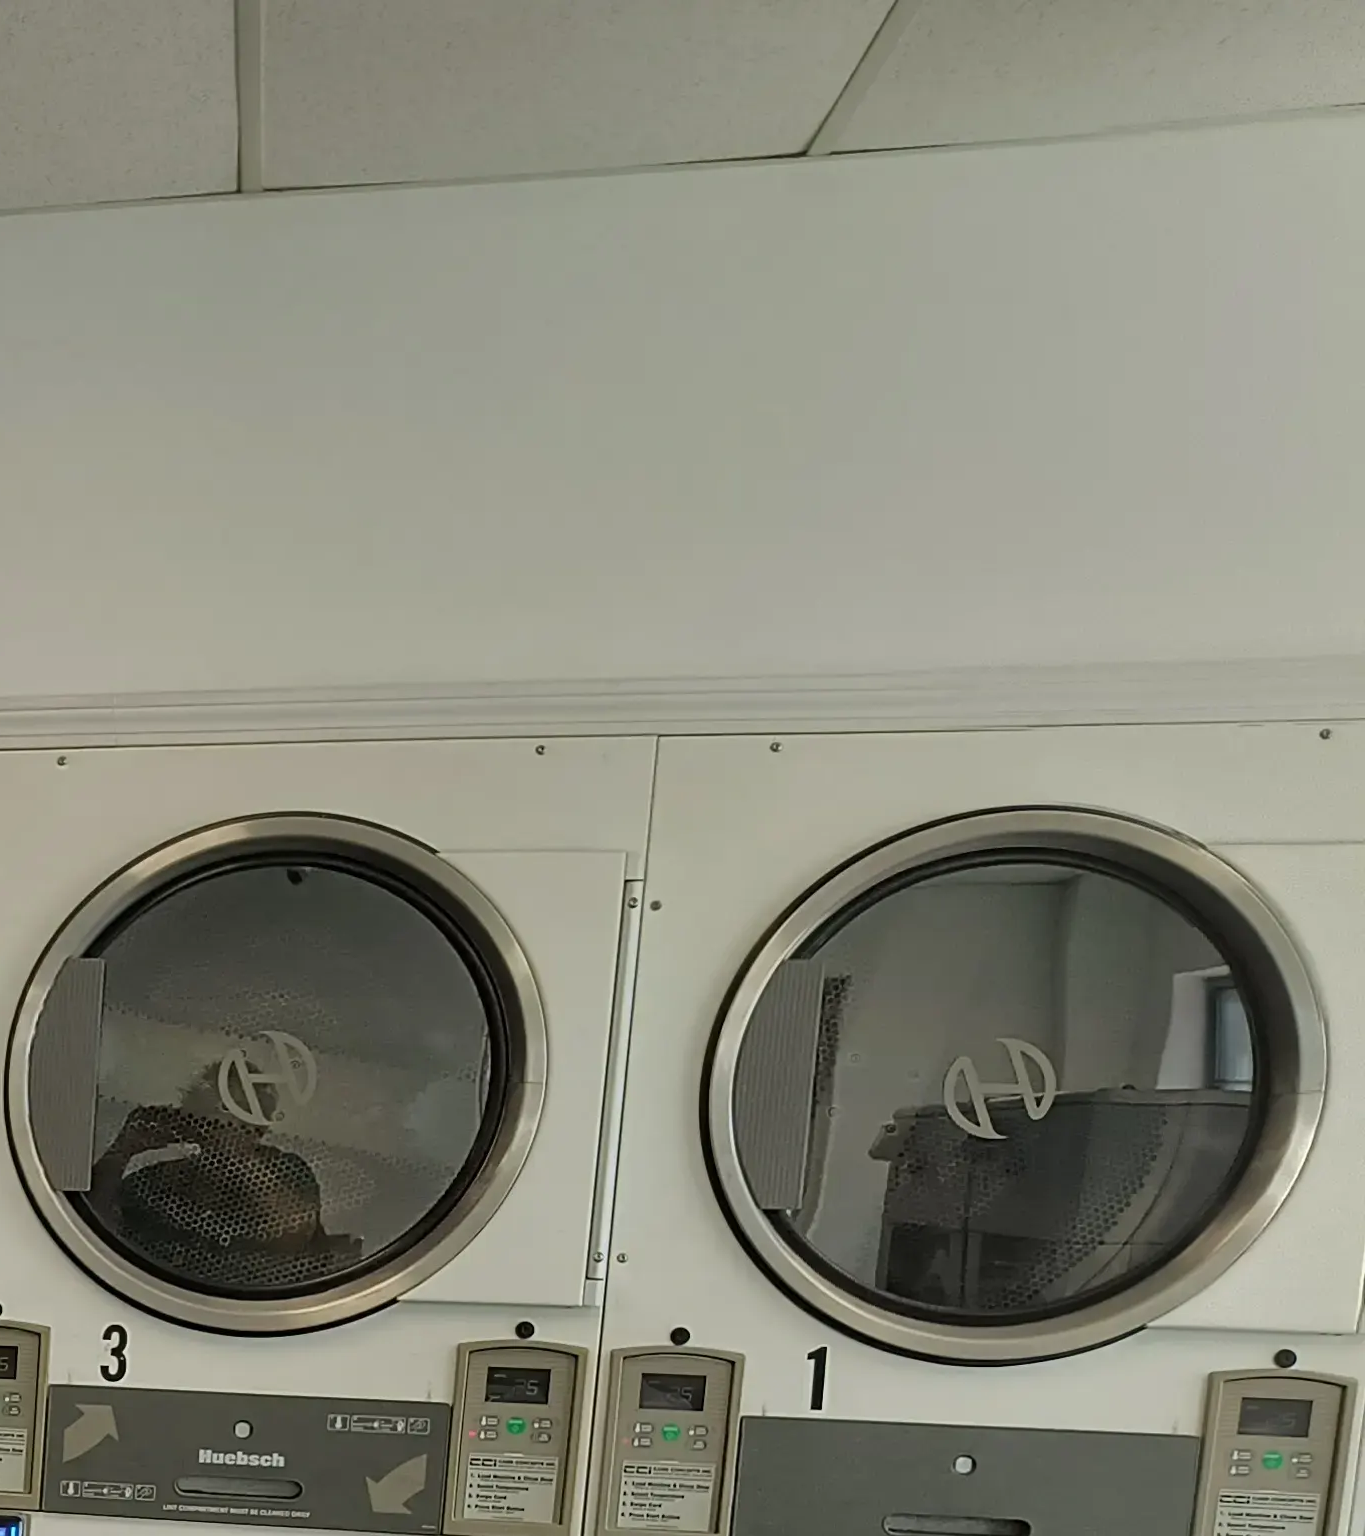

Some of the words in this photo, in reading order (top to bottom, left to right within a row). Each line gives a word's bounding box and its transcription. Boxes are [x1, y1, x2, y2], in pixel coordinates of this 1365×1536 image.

[99, 1324, 128, 1382] 3
[806, 1346, 828, 1411] 1
[198, 1448, 285, 1467] Huebsch
